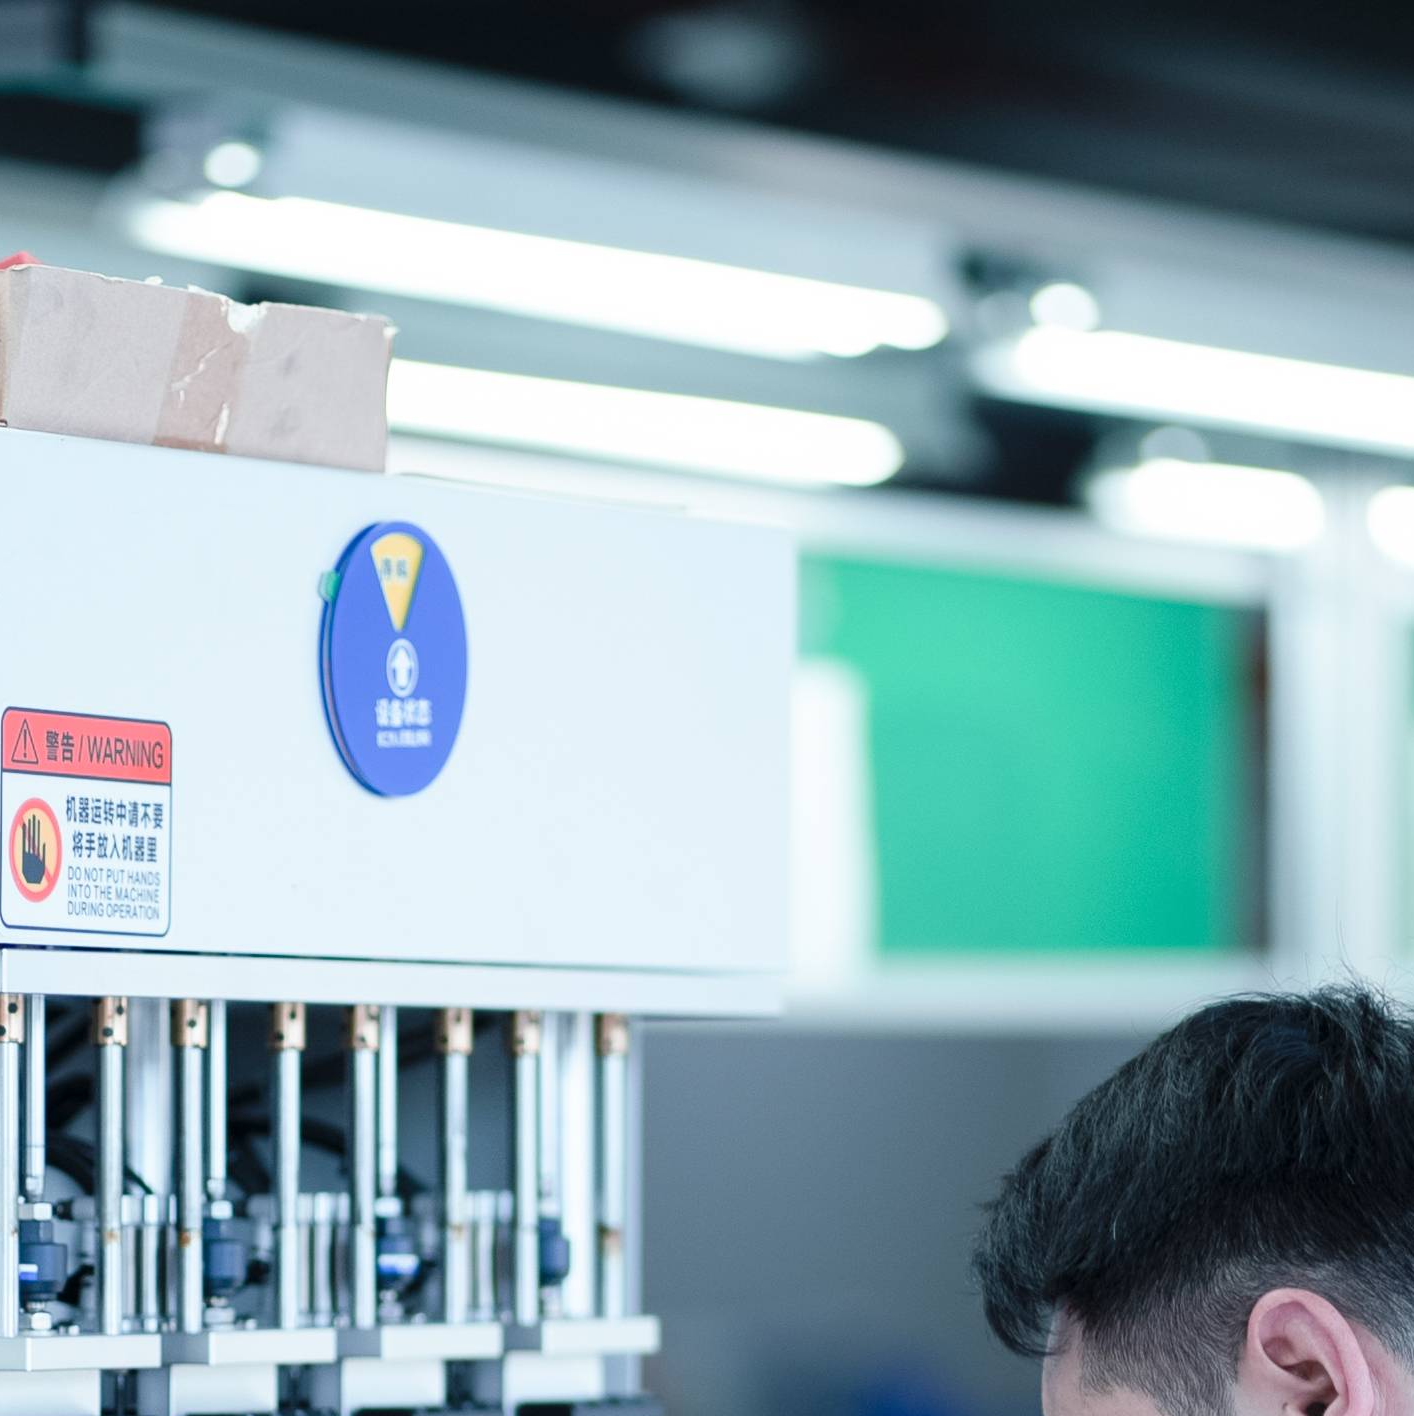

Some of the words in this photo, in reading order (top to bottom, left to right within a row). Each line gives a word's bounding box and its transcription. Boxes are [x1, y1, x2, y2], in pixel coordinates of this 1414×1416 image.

[46, 730, 74, 762] 警告
[87, 736, 164, 769] WARNING
[66, 796, 163, 830] 机器运转中请不要
[72, 832, 157, 863] 将手放入机器里
[67, 866, 81, 880] DO
[84, 867, 104, 882] NOT
[106, 868, 125, 884] PUT
[127, 870, 161, 886] HANDS
[67, 883, 91, 899] INTO
[94, 885, 112, 901] THE
[115, 888, 159, 904] MACHINE
[67, 900, 104, 918] DURING
[106, 903, 160, 920] OPERATION
